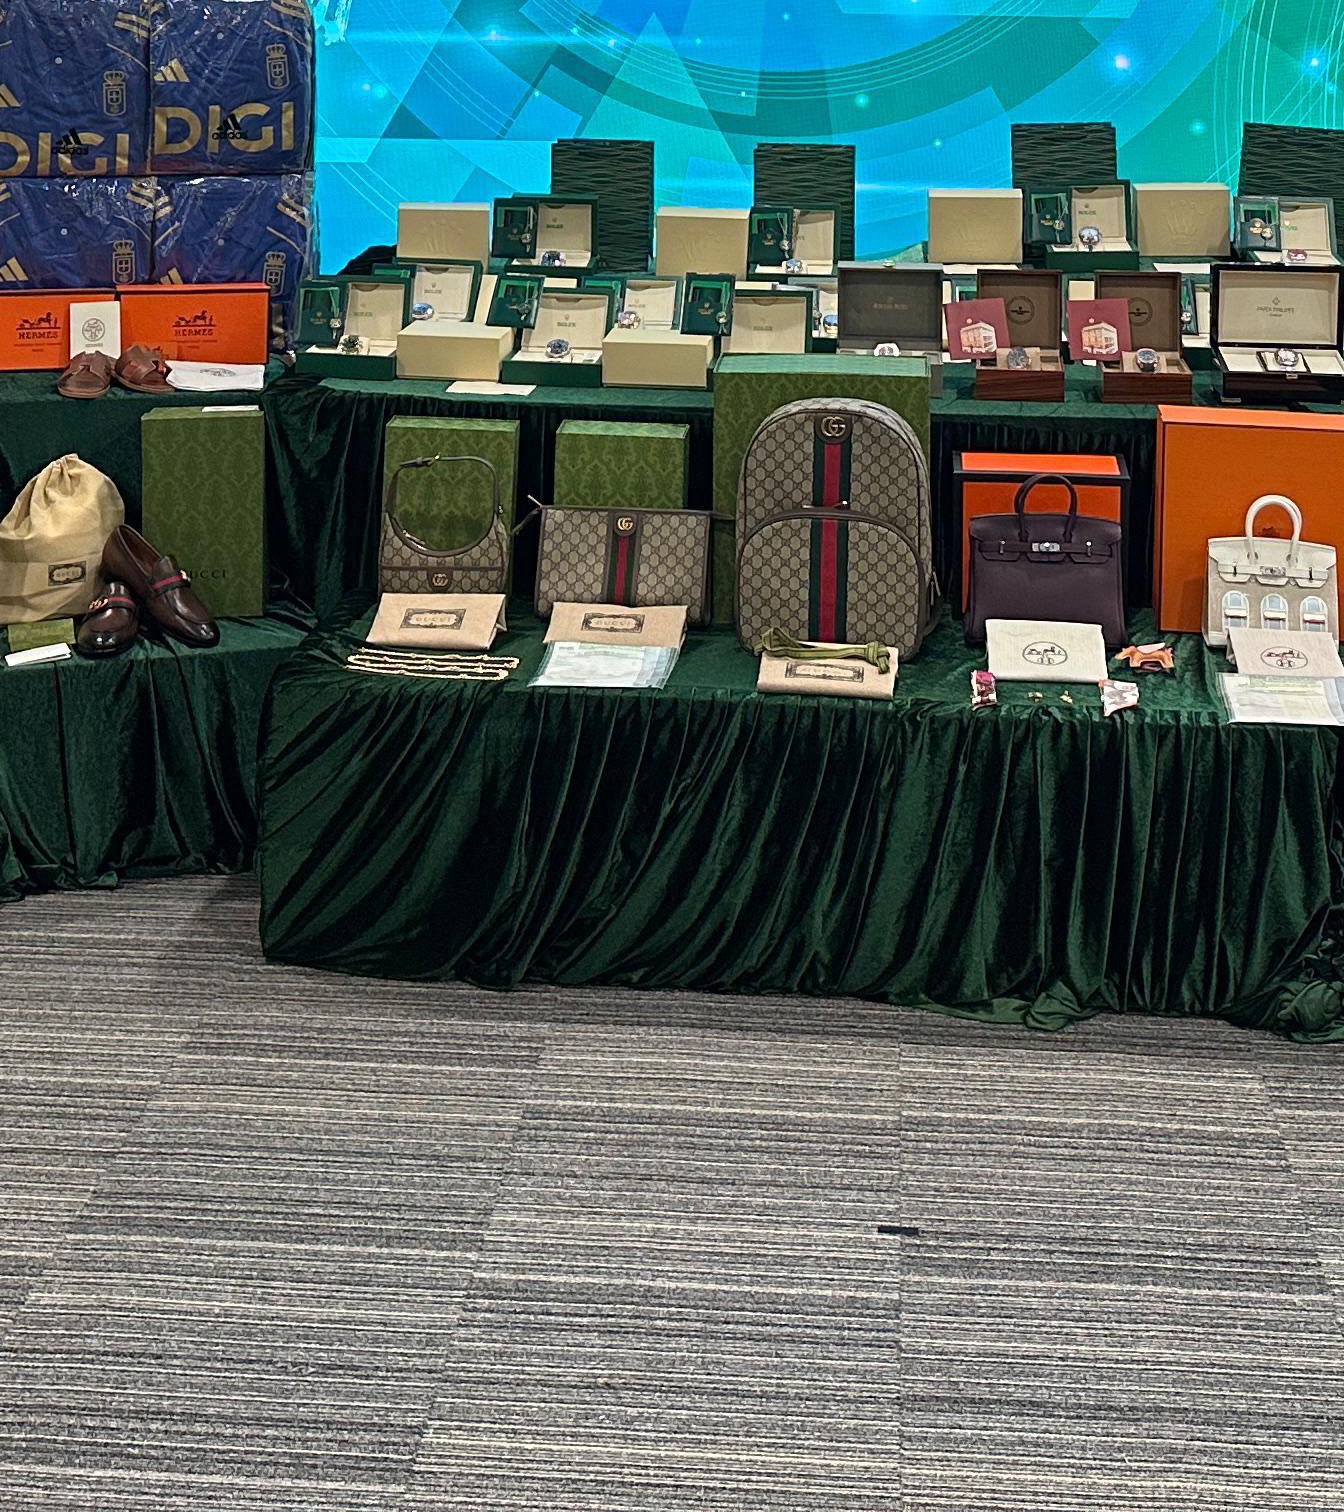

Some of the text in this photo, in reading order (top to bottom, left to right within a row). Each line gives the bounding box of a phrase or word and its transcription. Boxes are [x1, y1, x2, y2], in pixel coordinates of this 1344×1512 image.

[154, 100, 295, 155] DIGI
[211, 129, 249, 141] adidas
[50, 144, 89, 156] adidas
[190, 568, 227, 578] UCCI
